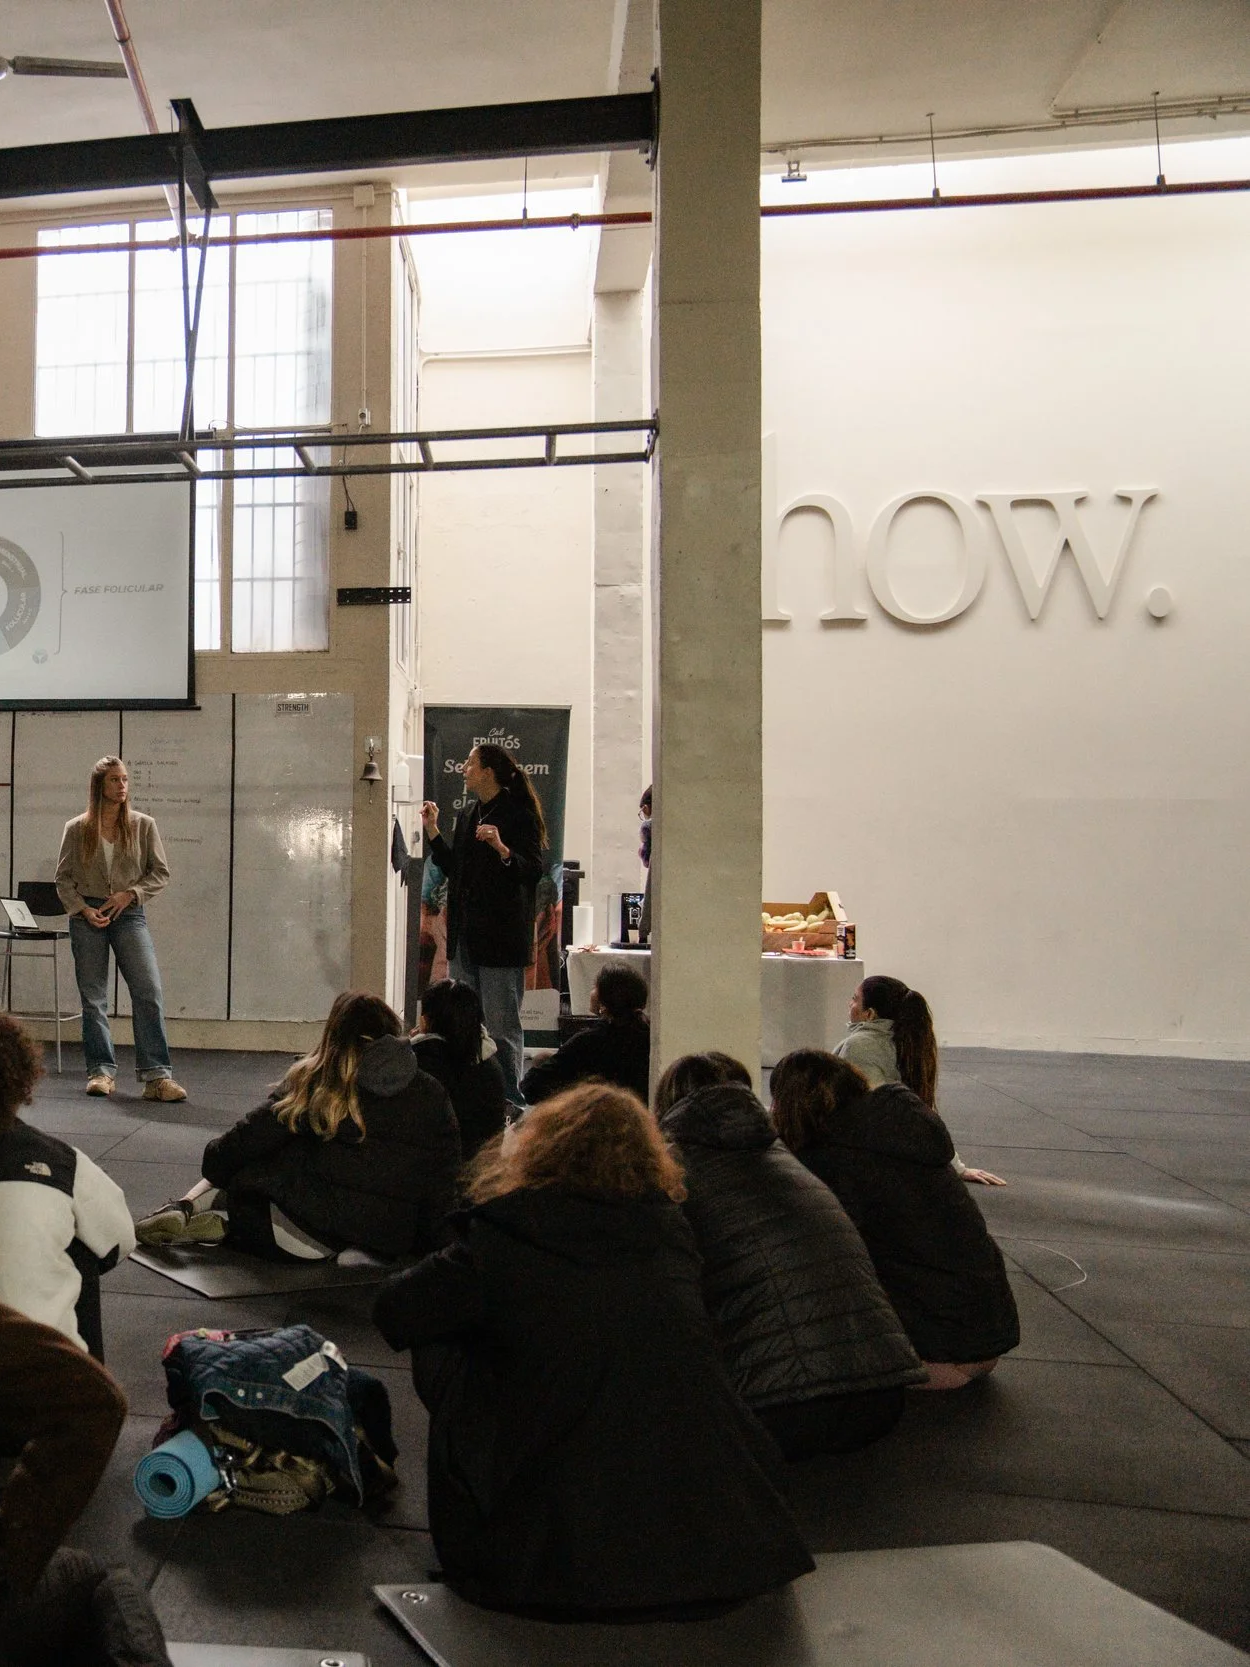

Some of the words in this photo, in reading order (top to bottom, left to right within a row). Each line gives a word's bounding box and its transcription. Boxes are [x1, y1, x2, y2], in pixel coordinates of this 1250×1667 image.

[74, 585, 101, 594] FASE
[103, 583, 165, 593] FOLICULAR
[277, 703, 309, 712] STRENGTH
